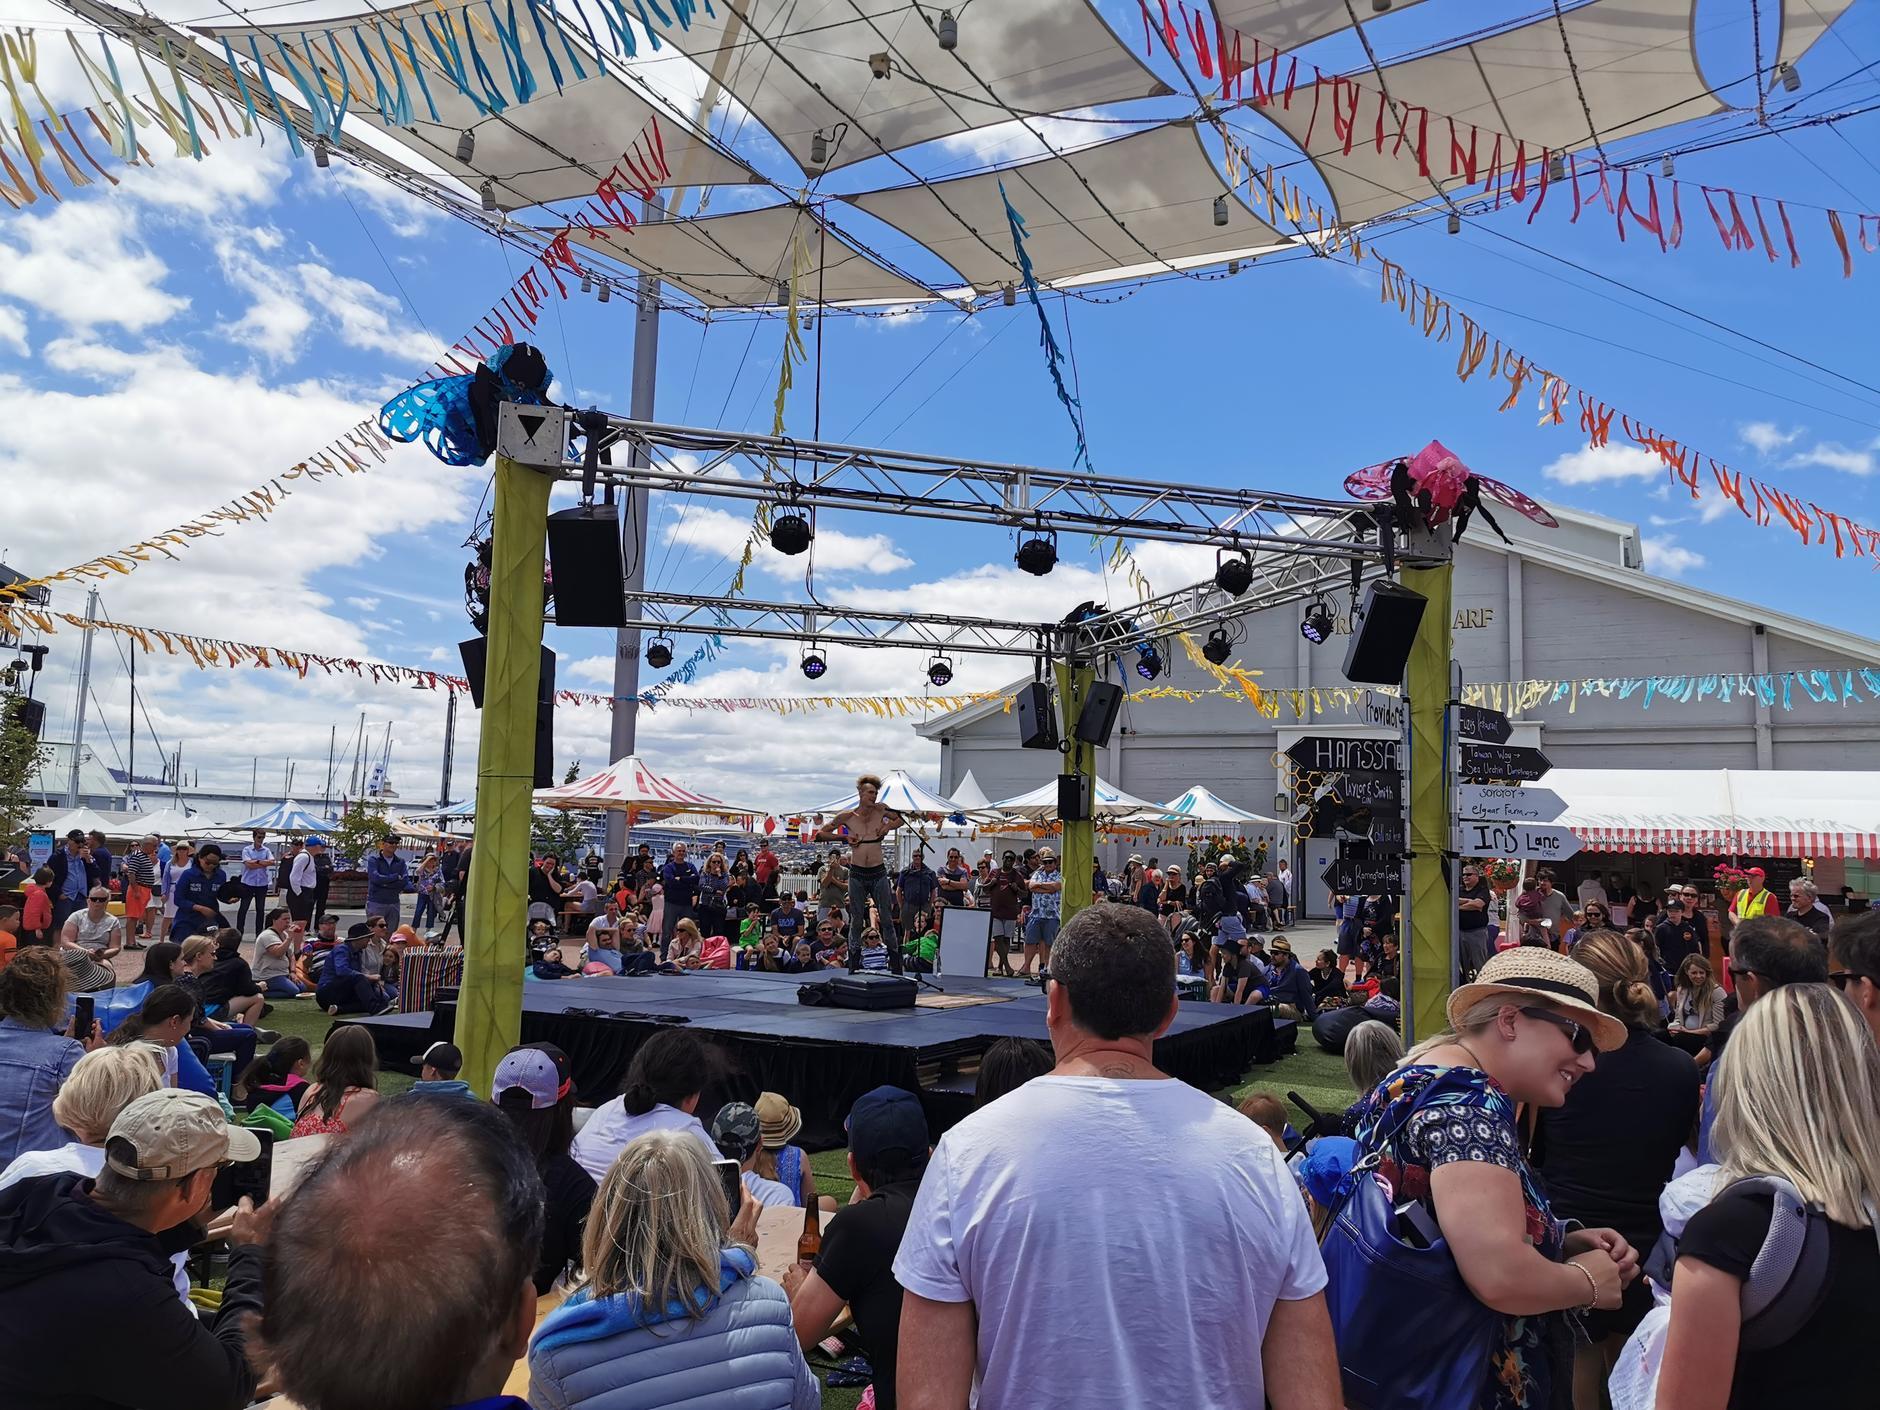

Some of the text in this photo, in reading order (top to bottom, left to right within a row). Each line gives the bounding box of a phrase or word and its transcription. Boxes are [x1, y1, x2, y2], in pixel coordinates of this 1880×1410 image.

[1450, 607, 1494, 630] ARF
[1497, 750, 1511, 764] Way
[1466, 760, 1480, 775] Sea
[1484, 763, 1503, 775] Urchin
[1373, 780, 1394, 800] Smith
[1505, 804, 1523, 816] Farm
[1526, 833, 1560, 851] Lane
[1652, 836, 1690, 847] CRAFT
[1746, 838, 1771, 849] BAR
[1337, 863, 1352, 890] Lake
